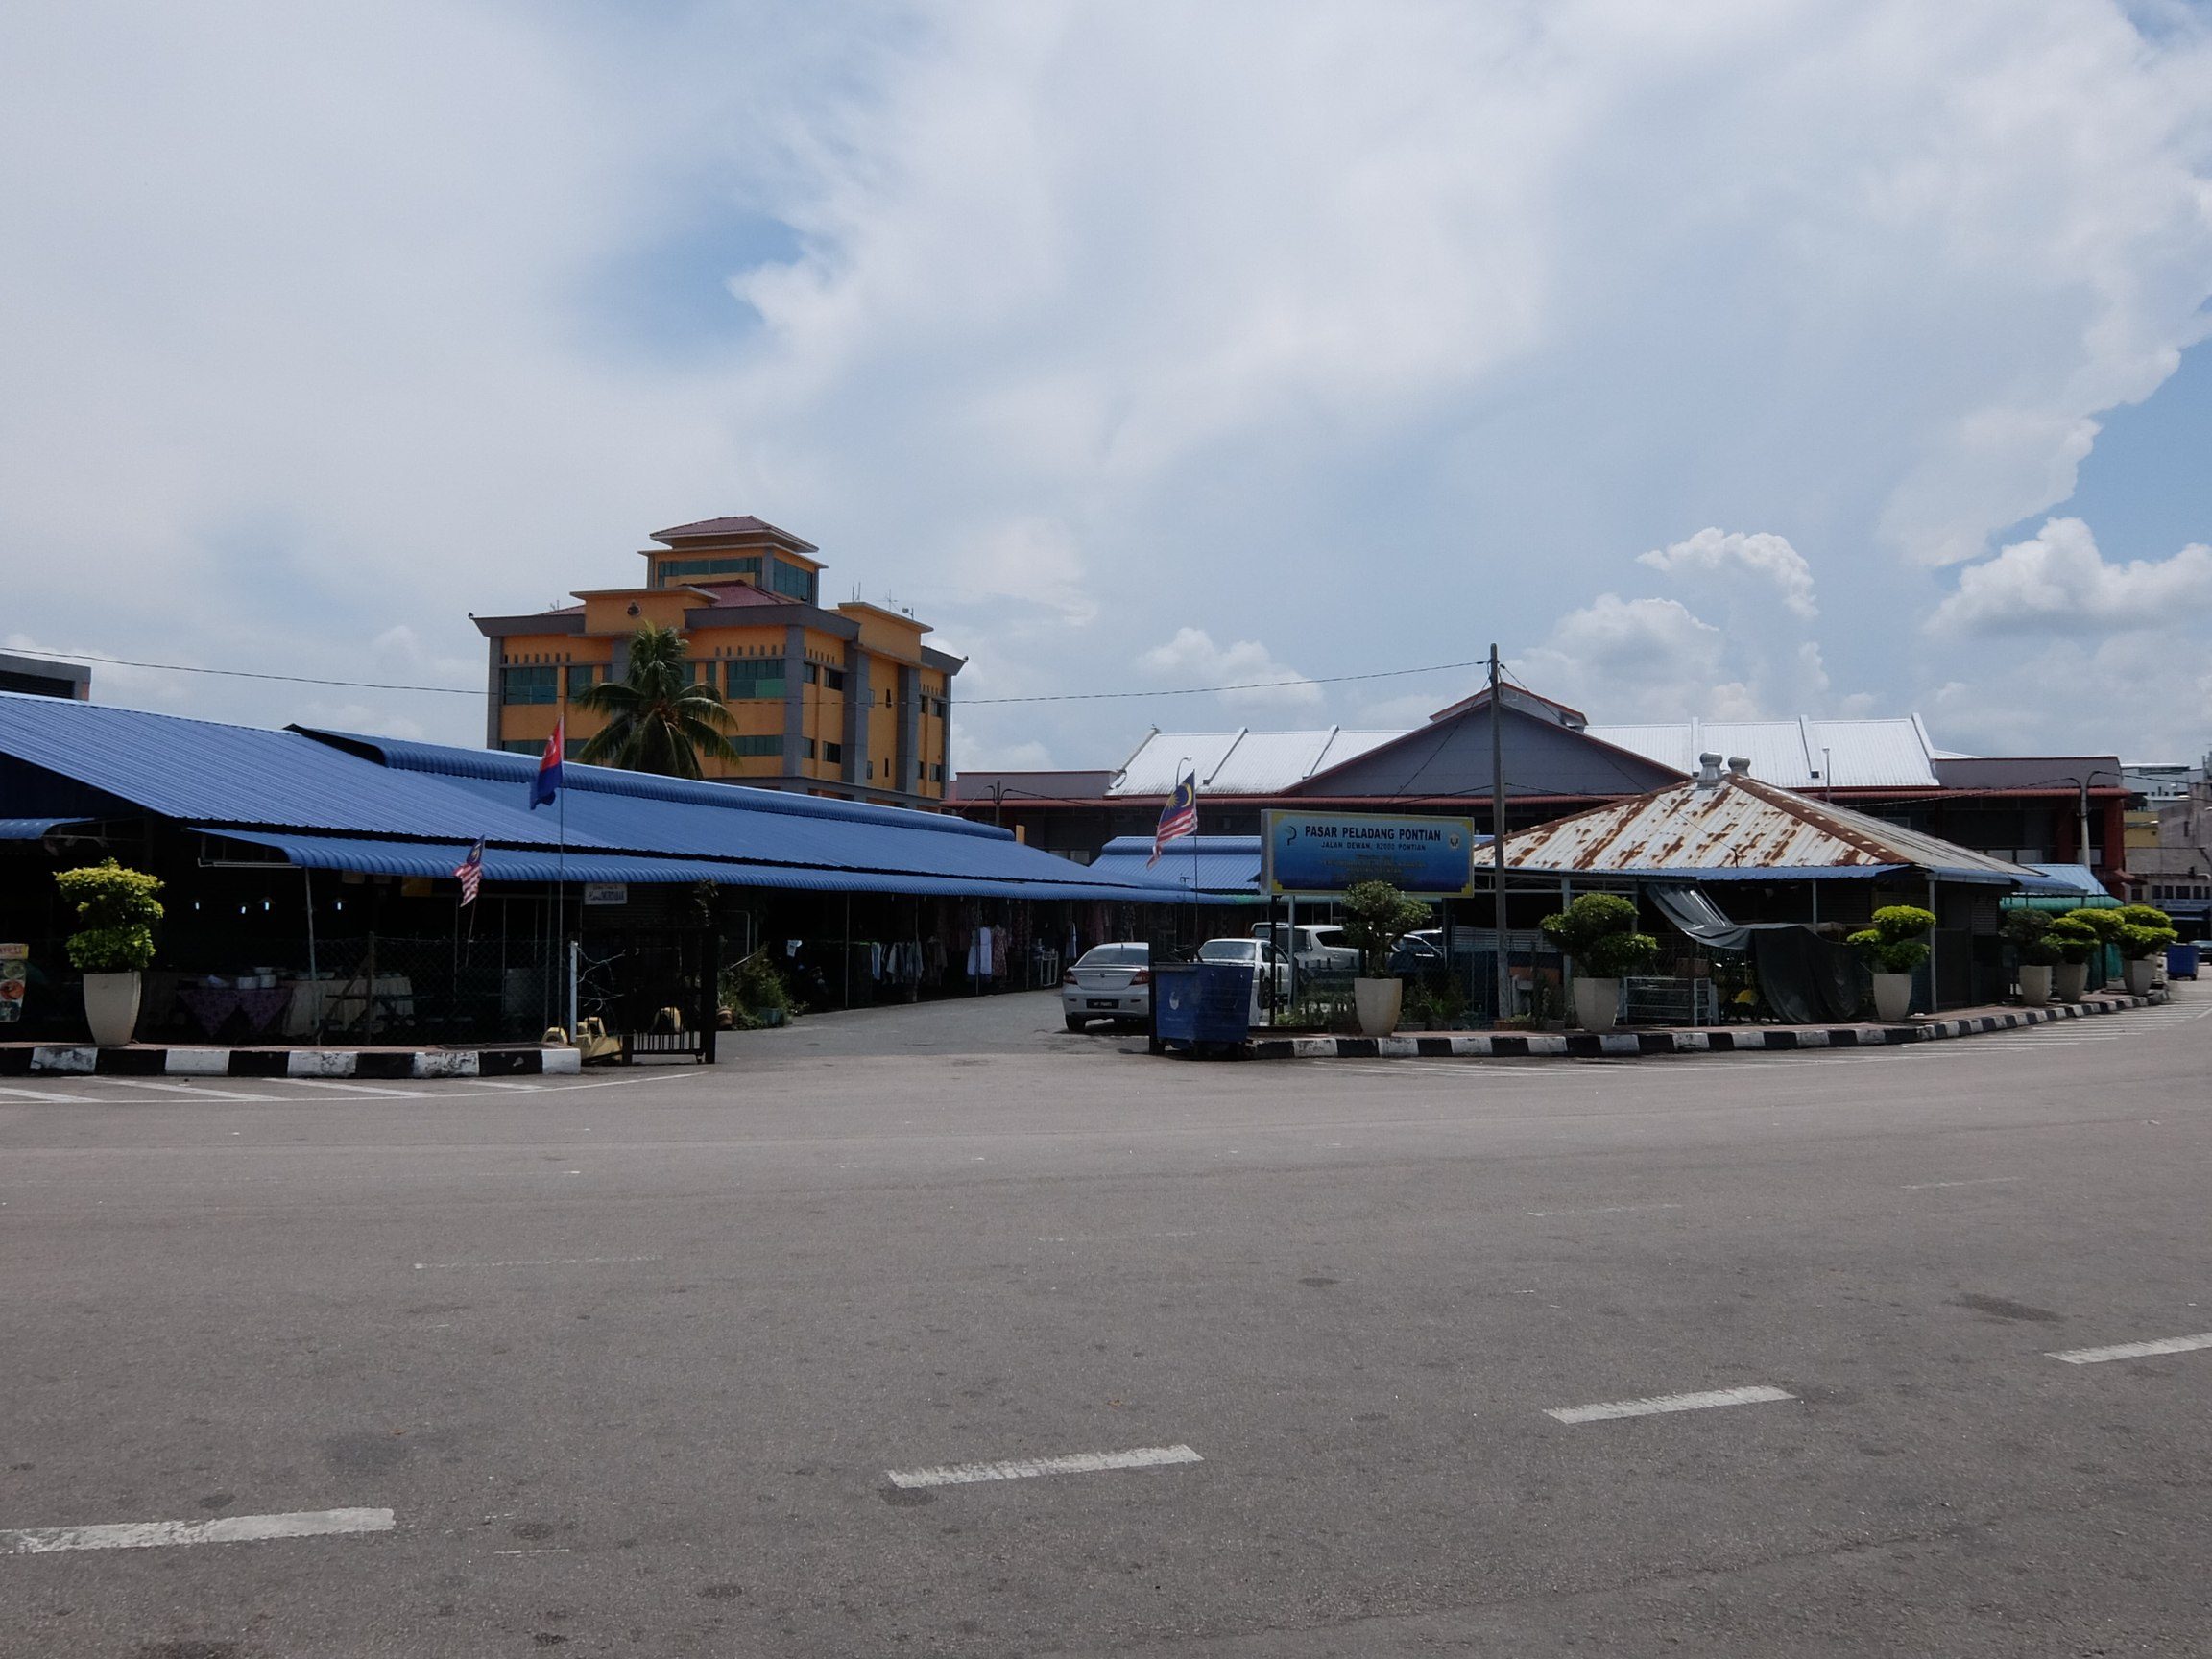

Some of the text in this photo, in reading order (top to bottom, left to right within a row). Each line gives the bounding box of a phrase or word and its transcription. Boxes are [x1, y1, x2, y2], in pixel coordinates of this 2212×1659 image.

[1305, 826, 1441, 841] PASAR PELADANG PONTIAN
